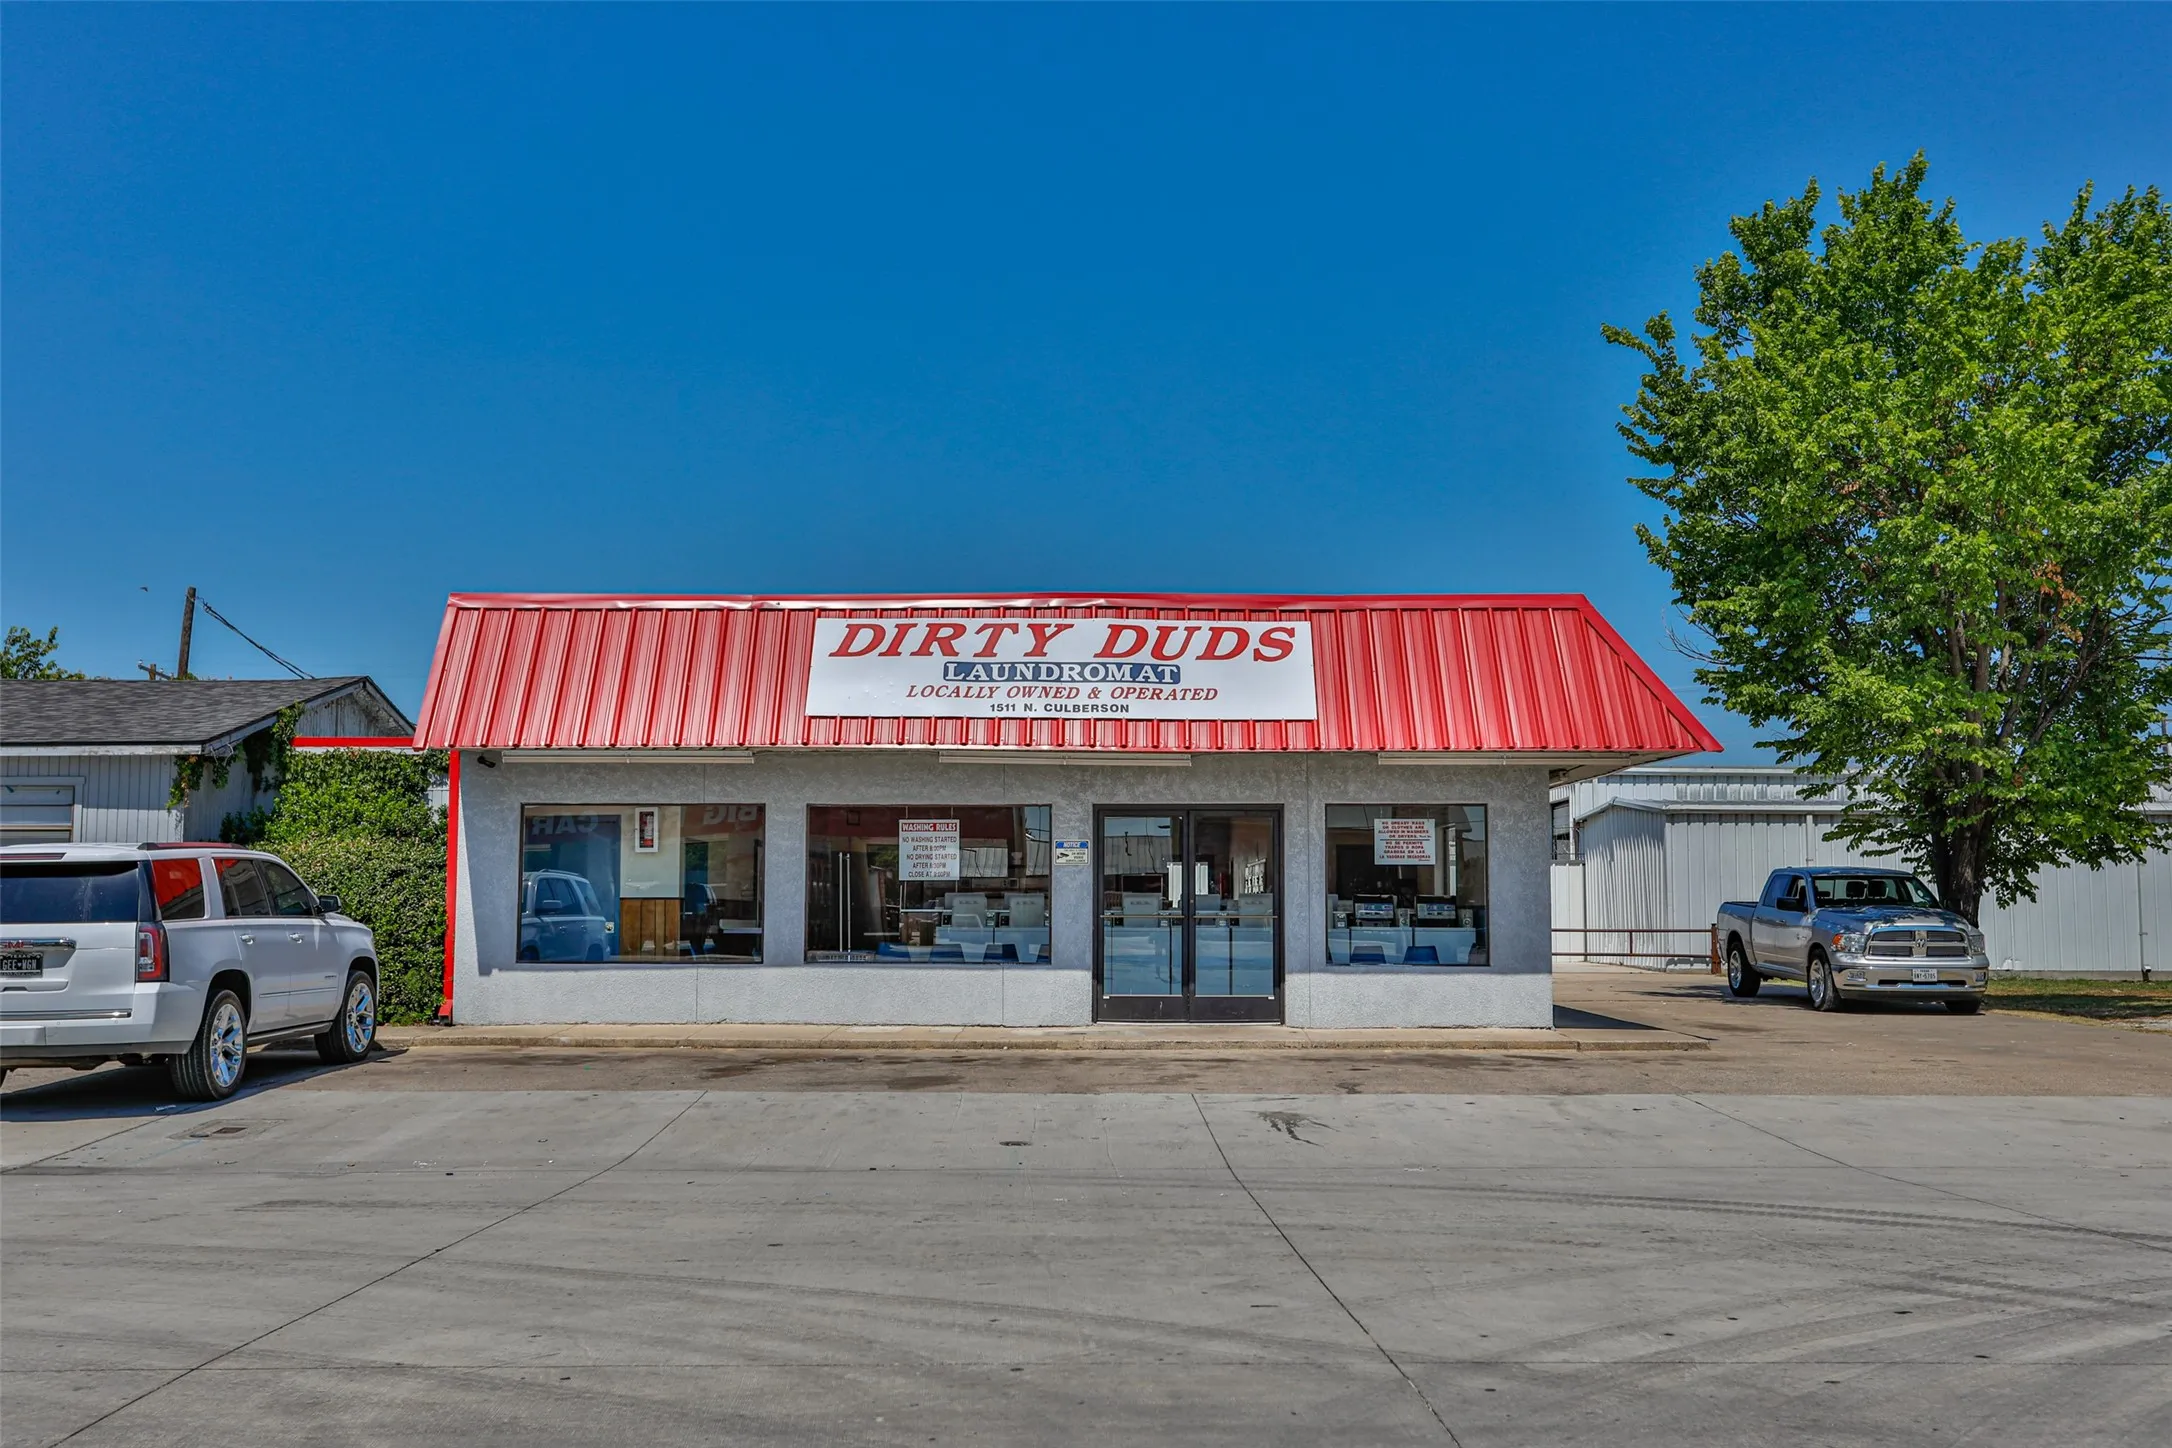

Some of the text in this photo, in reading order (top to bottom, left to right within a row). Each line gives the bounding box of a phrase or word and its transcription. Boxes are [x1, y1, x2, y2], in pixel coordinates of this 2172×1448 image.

[828, 622, 1296, 663] DIRTY DUDS
[945, 663, 1179, 683] LAUNDROMAT
[906, 685, 1218, 701] LOCALLY OWNED & OPERATED
[989, 703, 1130, 713] 1511 N. CULBERSON
[902, 823, 956, 831] WASHING RULES
